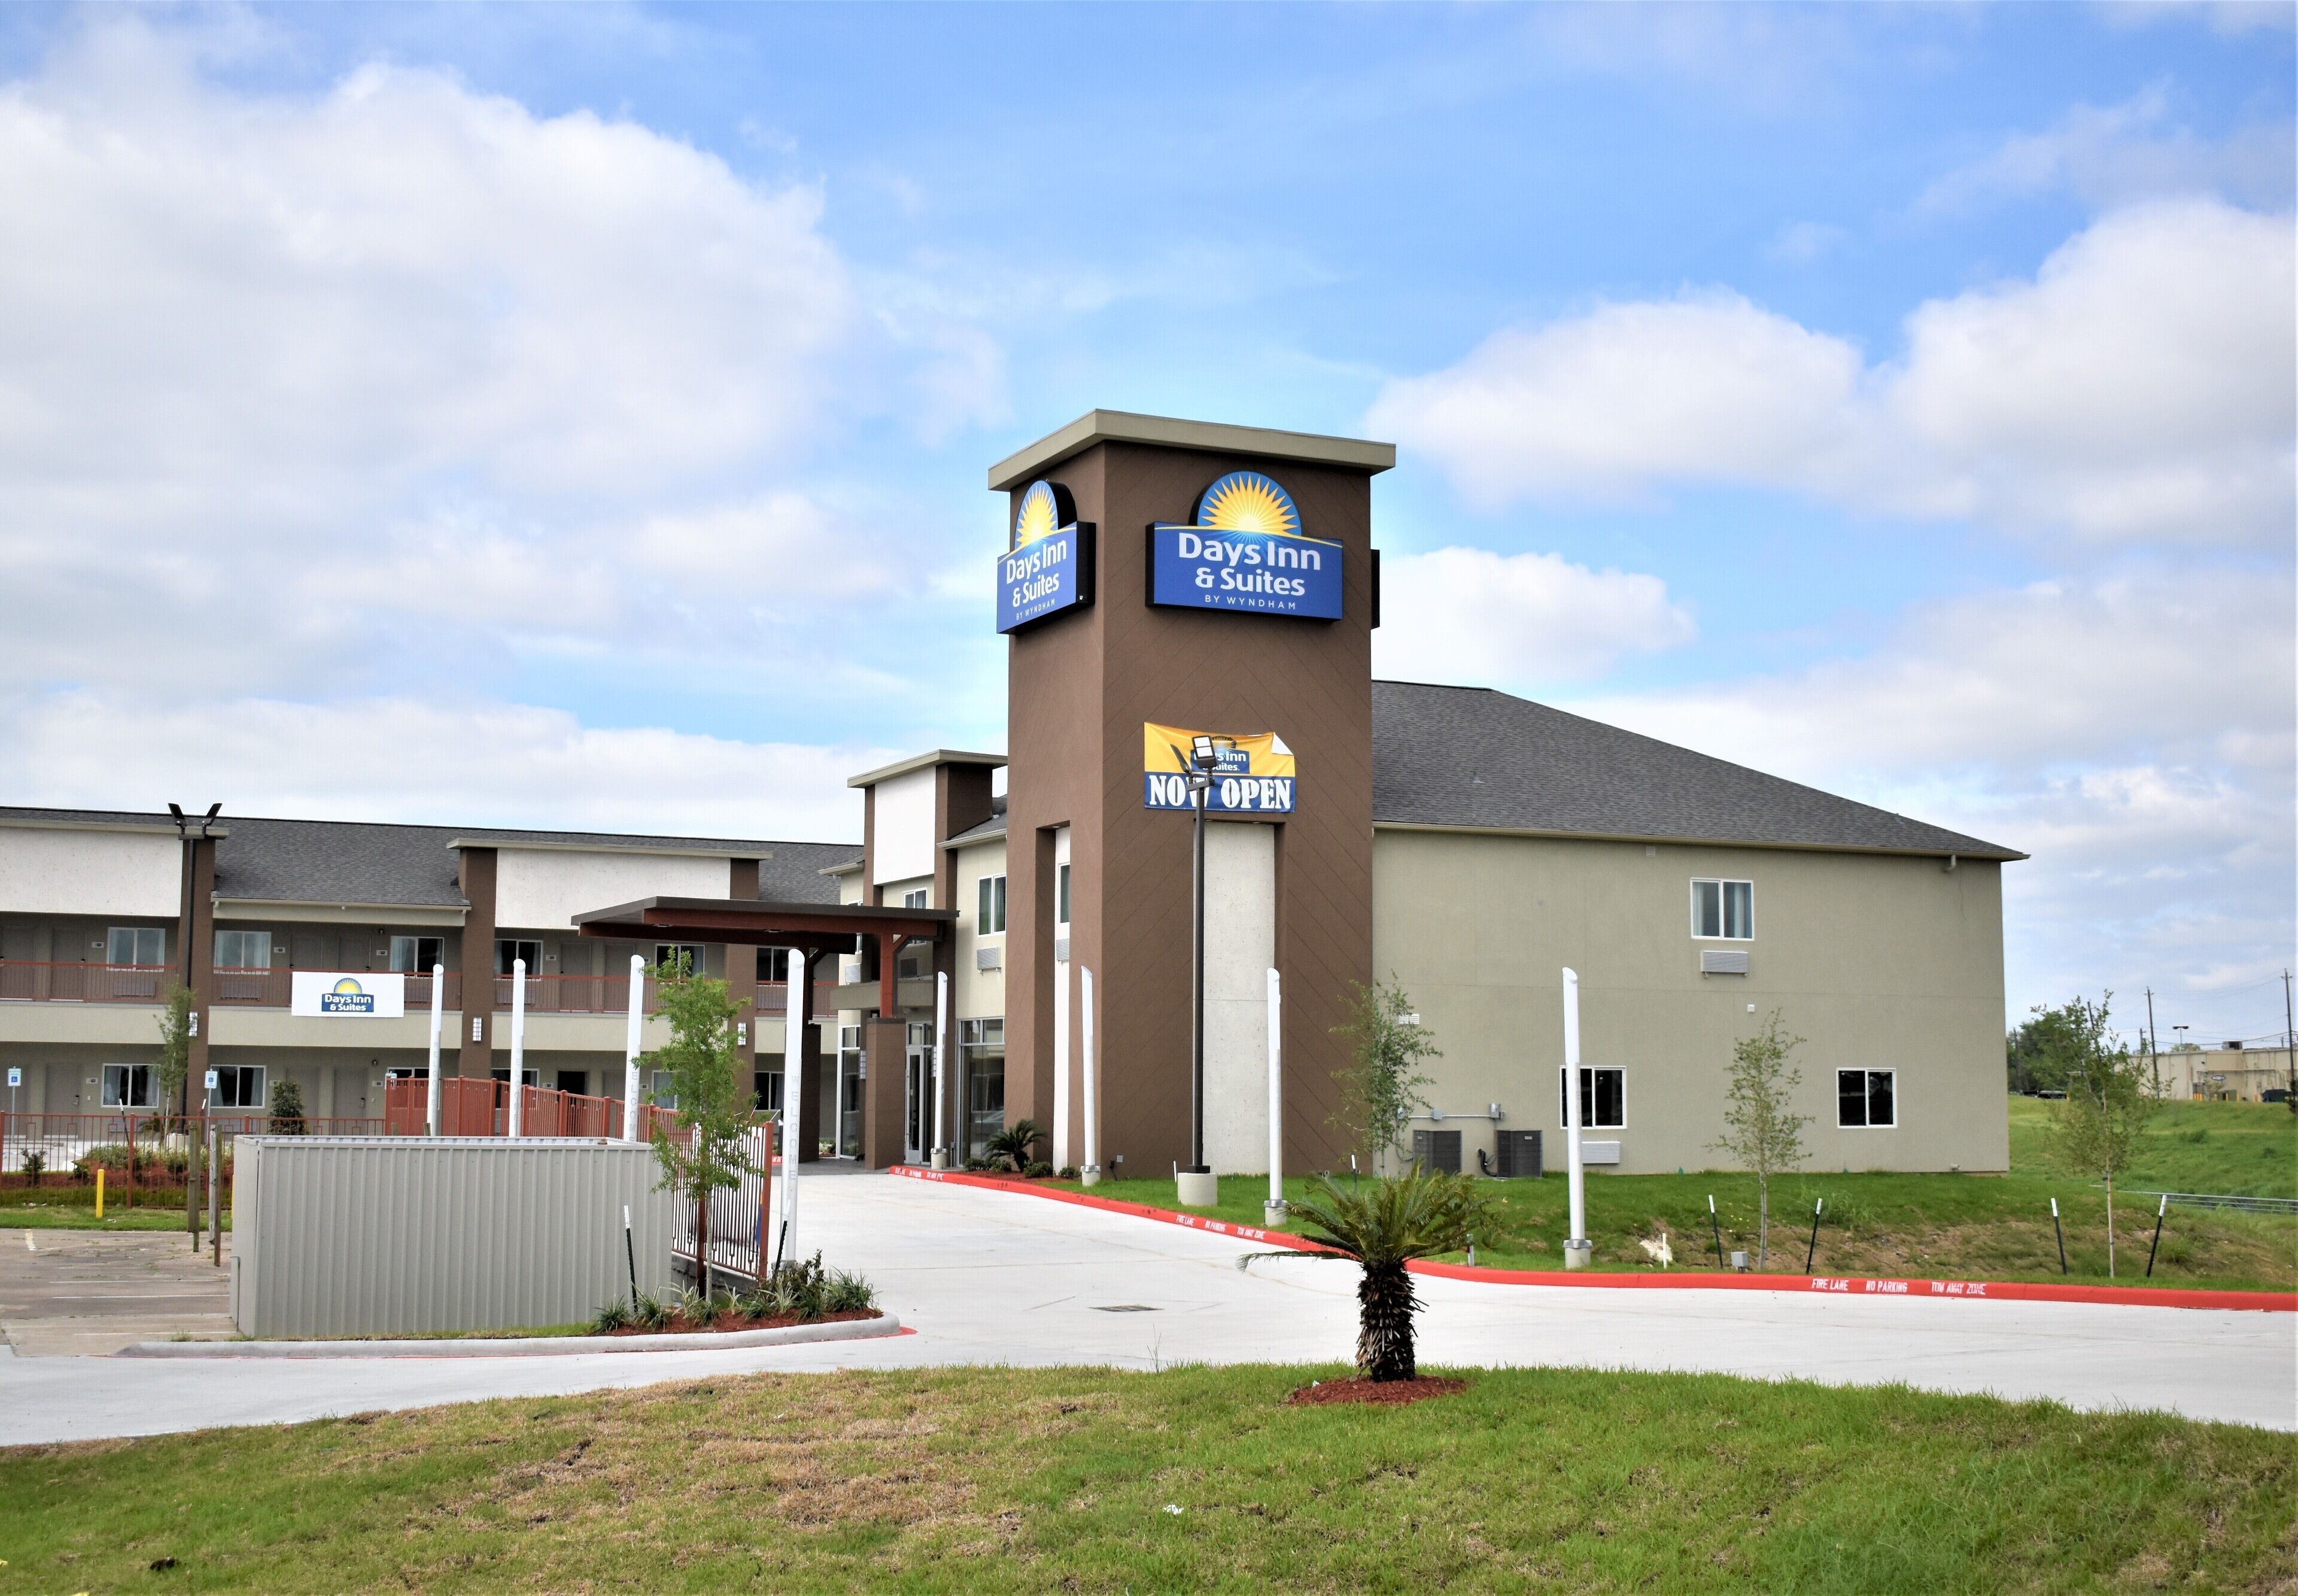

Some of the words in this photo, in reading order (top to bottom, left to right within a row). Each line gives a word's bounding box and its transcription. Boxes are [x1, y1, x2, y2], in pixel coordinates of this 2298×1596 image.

[1006, 551, 1040, 585] Days
[1042, 540, 1066, 569] Inn
[1179, 532, 1261, 566] Days
[1267, 541, 1320, 570] Inn
[1013, 587, 1021, 607] &
[1023, 573, 1059, 604] Suites
[1195, 567, 1214, 588] &
[1220, 568, 1305, 596] Suites
[1016, 612, 1023, 621] BY
[1025, 598, 1055, 616] WYNDHAM
[1205, 595, 1220, 603] BY
[1227, 597, 1296, 610] WYNDHAM
[1212, 762, 1238, 771] uites
[1226, 751, 1246, 762] Inn
[1149, 775, 1211, 808] NOW
[1220, 778, 1291, 809] OPEN
[325, 994, 351, 1004] Days
[629, 1071, 638, 1142] ELCOME
[789, 1075, 800, 1180] WELCOME
[1811, 1278, 1829, 1289] FIRE
[1830, 1279, 1849, 1291] LANE
[1865, 1280, 1876, 1291] NO
[1877, 1281, 1908, 1293] PARKING
[1931, 1281, 1945, 1293] TOW
